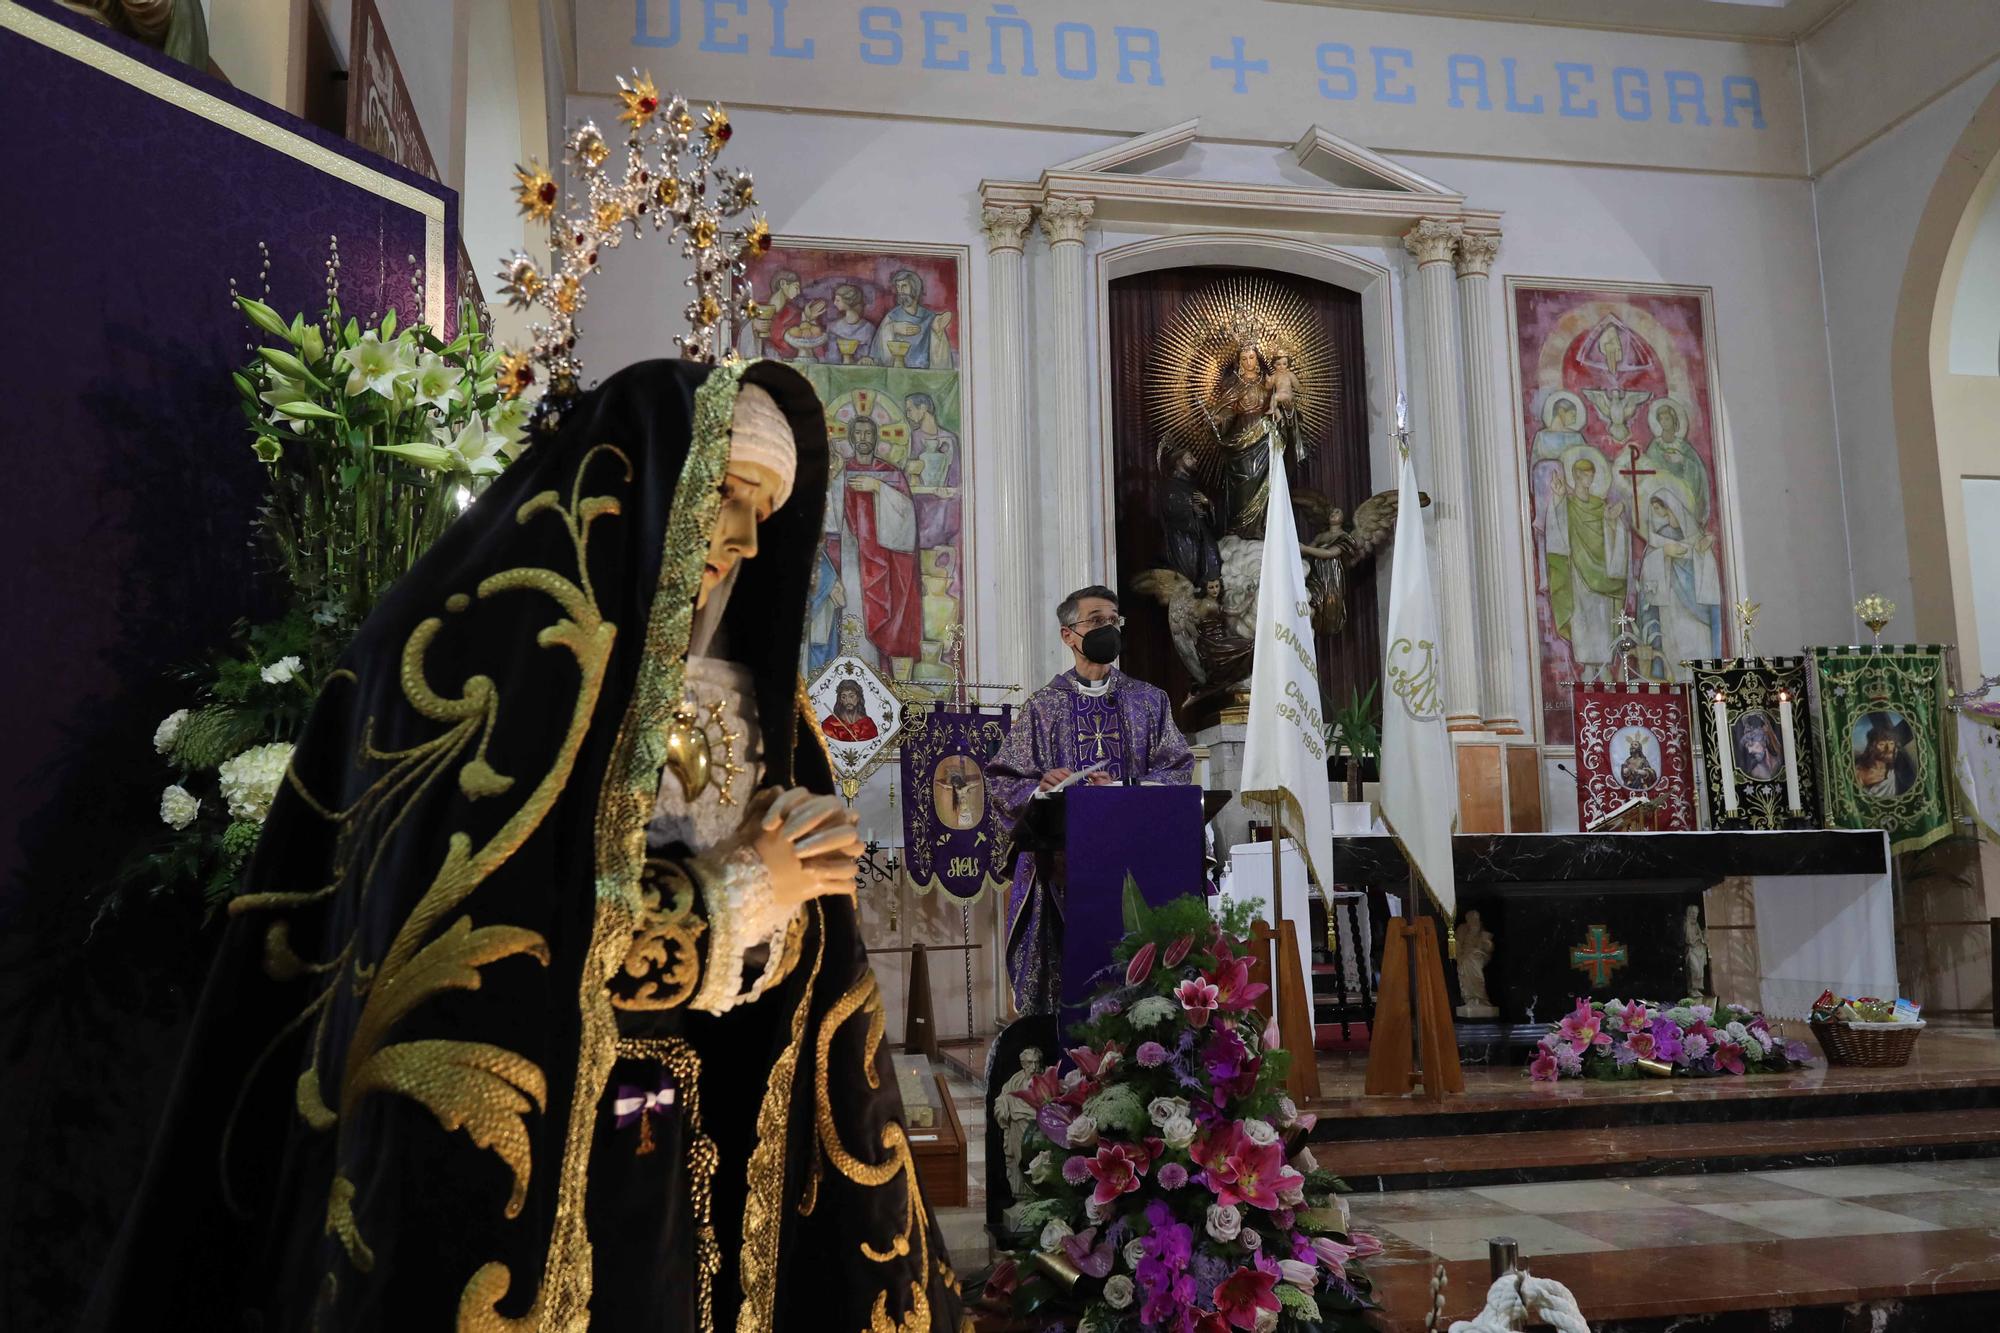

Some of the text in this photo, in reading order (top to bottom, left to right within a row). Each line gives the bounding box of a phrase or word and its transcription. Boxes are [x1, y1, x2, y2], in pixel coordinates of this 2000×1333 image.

[632, 0, 1767, 130] DEL SEÑOR SE ALEGRA
